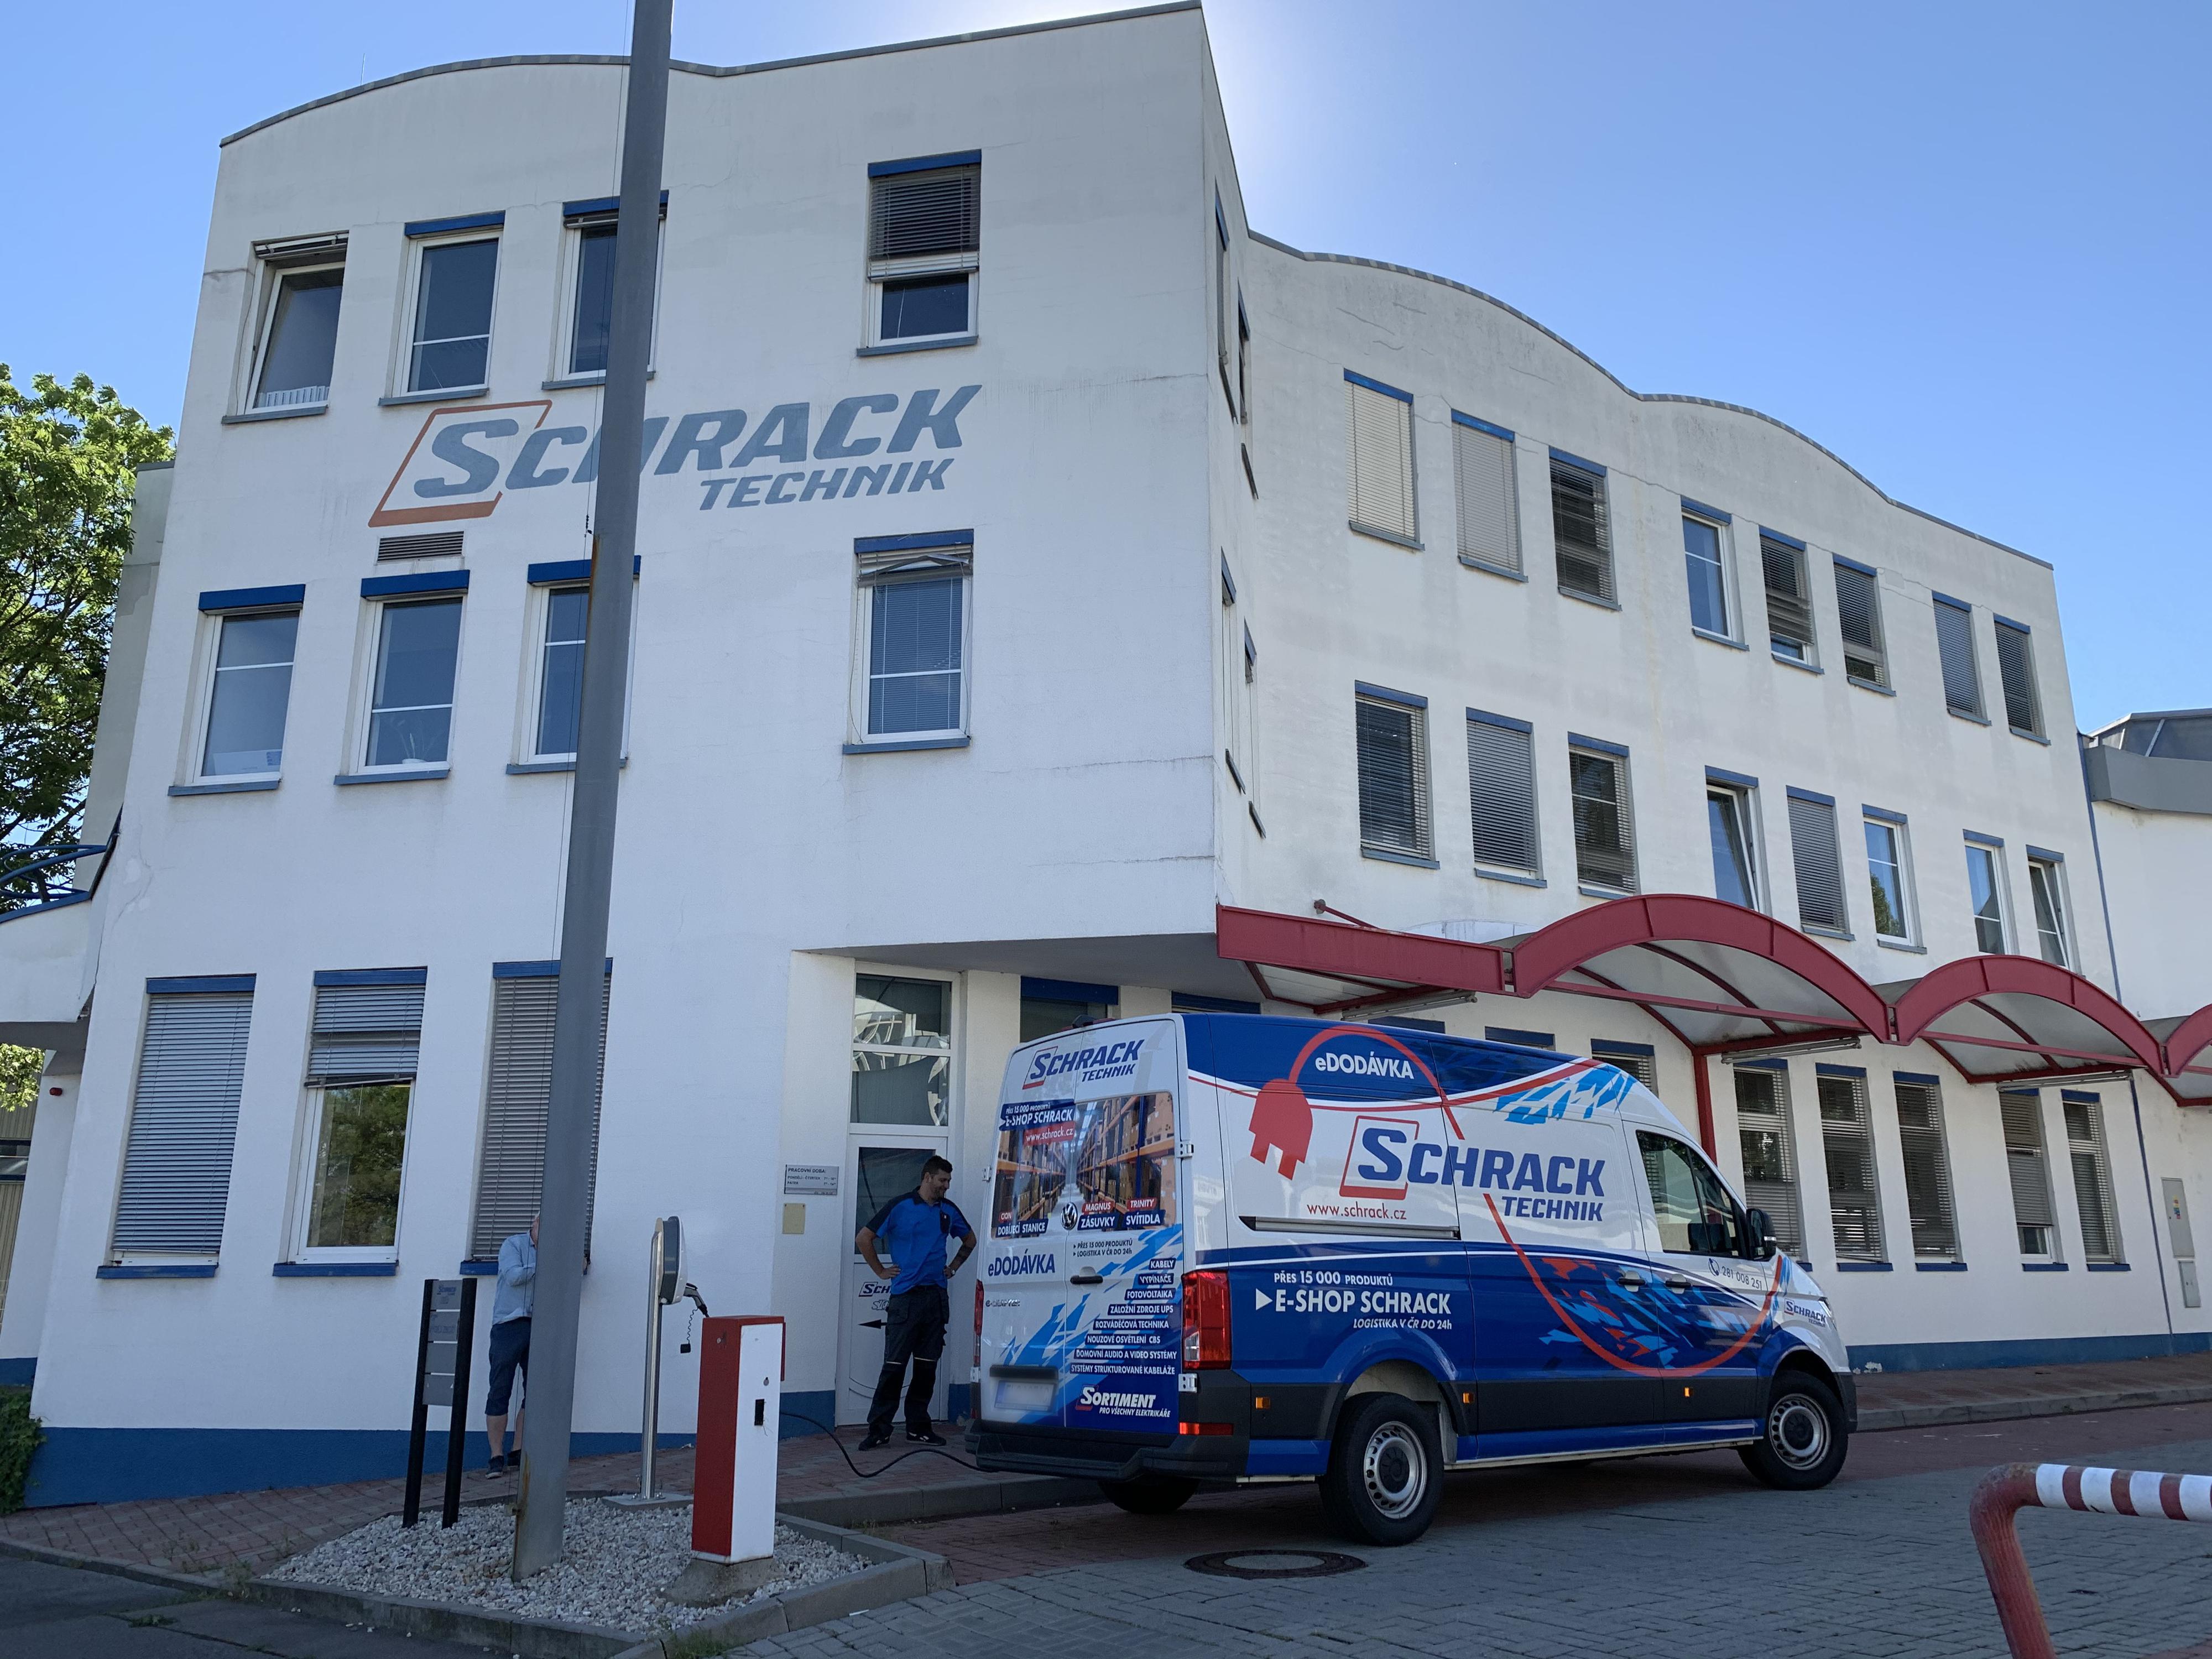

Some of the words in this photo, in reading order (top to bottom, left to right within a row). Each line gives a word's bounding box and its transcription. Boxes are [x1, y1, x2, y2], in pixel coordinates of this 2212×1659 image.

[699, 458, 954, 511] TECHNIK
[1030, 1039, 1145, 1079] SCHRACK
[1315, 1052, 1414, 1079] eDODÁVKA
[1082, 1063, 1136, 1082] TECHNIK
[1020, 1104, 1029, 1113] 000
[1005, 1113, 1032, 1126] E-SHOP
[1033, 1109, 1073, 1124] SCHRACK
[1026, 1126, 1073, 1141] www.schrack.cz
[1358, 1127, 1605, 1197] SCHRACK
[1085, 1202, 1111, 1212] MAGNUS
[1130, 1199, 1154, 1208] TRINITY
[1502, 1196, 1603, 1222] TECHNIK
[1307, 1202, 1407, 1220] www.schrack.cz
[1081, 1215, 1115, 1228] ZÁSUVKY
[1126, 1212, 1161, 1225] SVÍTIDLA
[998, 1222, 1020, 1235] DOBÍJECÍ
[1022, 1222, 1045, 1233] STANICE
[1105, 1238, 1133, 1247] PRODUKTŮ
[988, 1249, 1055, 1276] eDODÁVKA
[1151, 1260, 1174, 1269] KABELY
[1140, 1274, 1172, 1283] VYPÍNAČE
[1274, 1270, 1297, 1284] PŘES
[1300, 1271, 1313, 1284] 15
[1316, 1271, 1340, 1285] 000
[1345, 1274, 1393, 1286] PRODUKTŮ
[1721, 1266, 1734, 1279] 281
[1736, 1272, 1749, 1285] 008
[1751, 1278, 1762, 1291] 251
[1127, 1290, 1173, 1298] FOTOVOLTAIKA
[1276, 1289, 1355, 1312] E-SHOP
[1360, 1291, 1451, 1314] SCHRACK
[1110, 1304, 1136, 1313] ZÁLOŽNÍ
[1136, 1305, 1160, 1313] ZDROJE
[1786, 1301, 1826, 1323] SCHRACK
[1095, 1319, 1138, 1328] ROZVÁDĚČOVÁ
[1353, 1318, 1398, 1328] LOGISTIKA
[1400, 1319, 1406, 1328] V
[1407, 1317, 1419, 1329] ČR
[1421, 1319, 1435, 1329] DO
[1437, 1319, 1452, 1329] 24h
[1087, 1334, 1115, 1343] NOUZOVÉ
[1115, 1334, 1146, 1343] OSVĚTLENÍ
[1076, 1349, 1103, 1358] DOMOVNÍ
[1149, 1349, 1177, 1359] SYSTÉMY
[1071, 1364, 1093, 1373] SYSTÉMY
[1094, 1365, 1142, 1374] STRUKTUROVANÉ
[1144, 1365, 1175, 1375] KABELÁŽE
[1080, 1386, 1156, 1408] SORTIMENT
[1111, 1406, 1135, 1416] VŠECHNY
[1135, 1408, 1171, 1418] ELEKTRIKÁŘE
